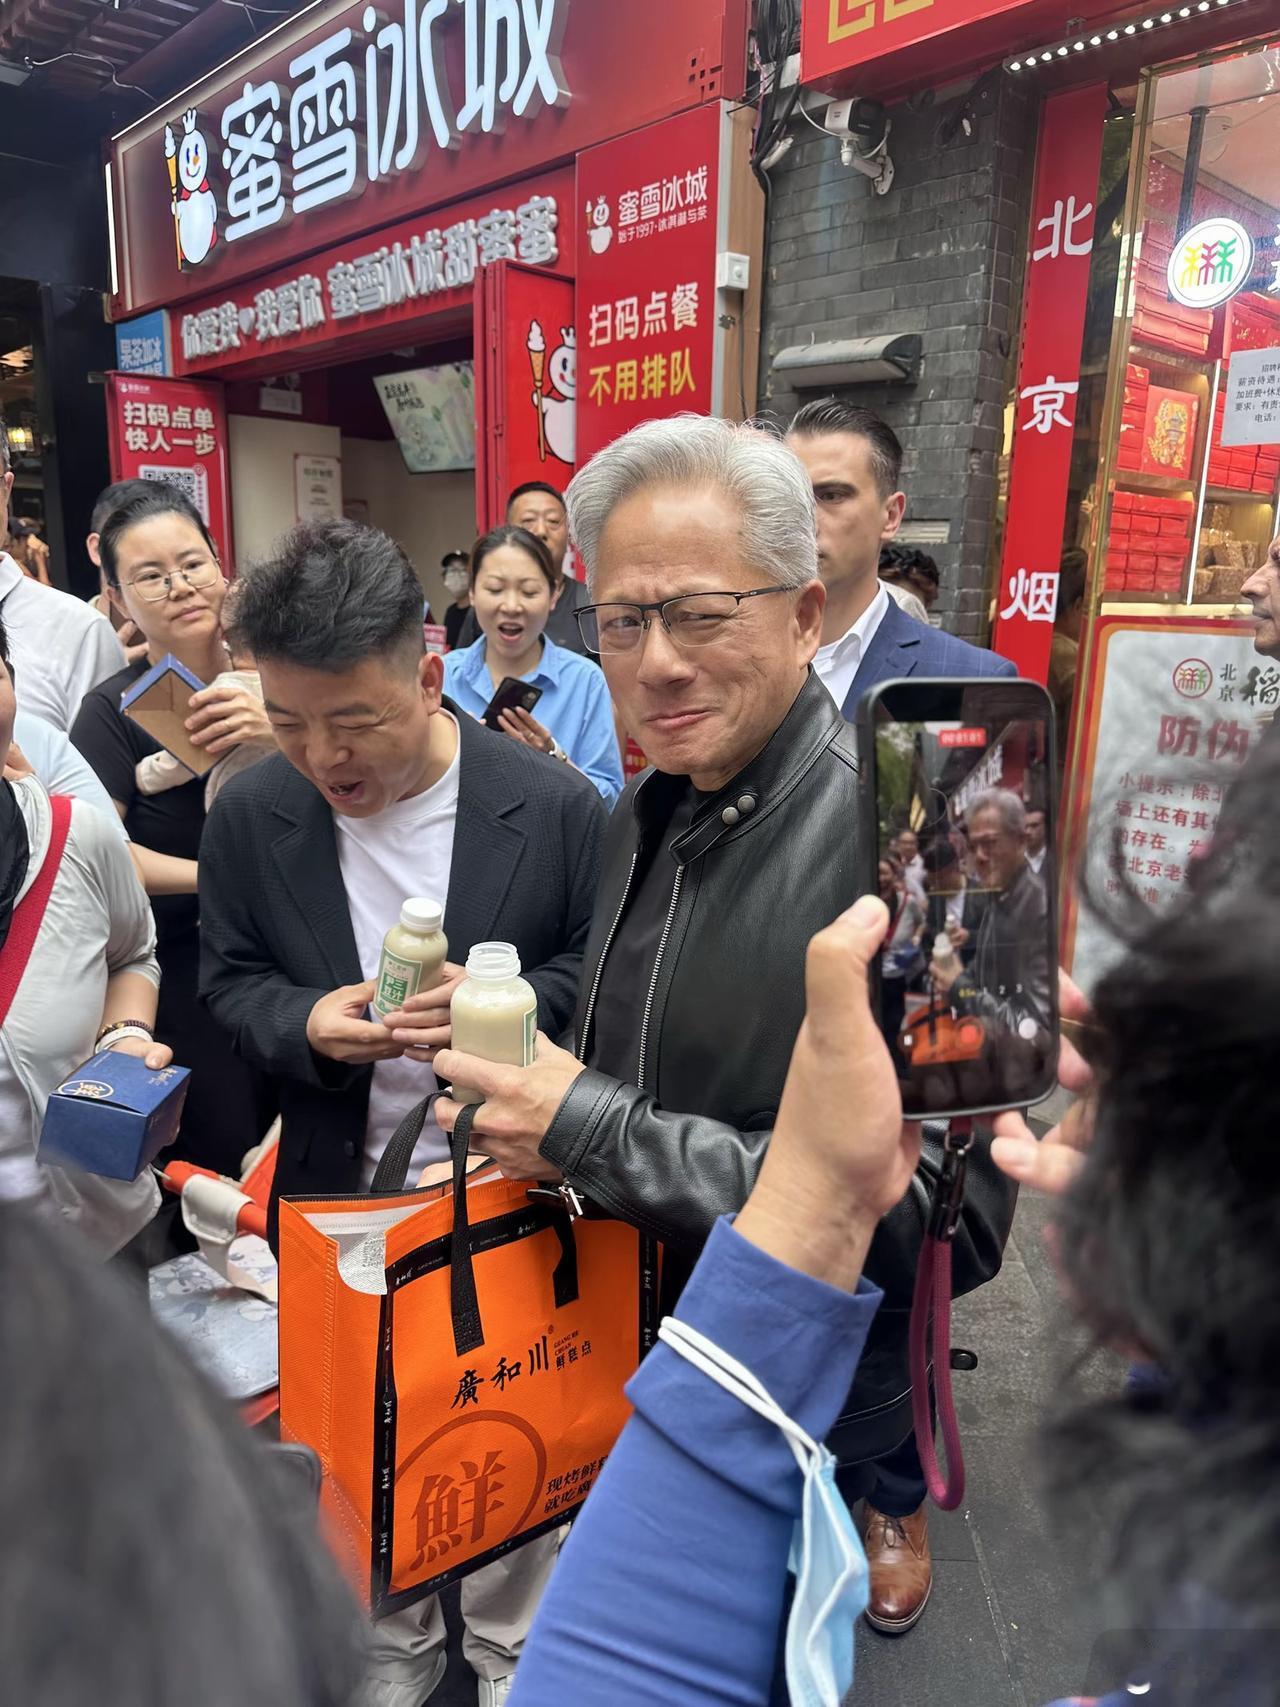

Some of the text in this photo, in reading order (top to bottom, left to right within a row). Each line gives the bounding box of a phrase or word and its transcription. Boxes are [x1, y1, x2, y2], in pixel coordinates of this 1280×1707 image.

[221, 0, 562, 243] 蜜雪冰城
[618, 165, 708, 227] 蜜雪冰城
[588, 282, 699, 348] 扫码点餐
[588, 348, 696, 407] 不用排队
[1238, 374, 1280, 387] 薪资待遇
[1262, 363, 1280, 374] 招聘
[124, 401, 215, 431] 扫码点单
[1234, 399, 1280, 412] 要求：有责
[125, 427, 217, 455] 快人一步
[1156, 713, 1268, 766] 防伪
[1115, 800, 1219, 832] 场上还有其
[1109, 852, 1193, 882] 北京老
[451, 1335, 549, 1409] 廣和川
[409, 1450, 507, 1572] 鮮
